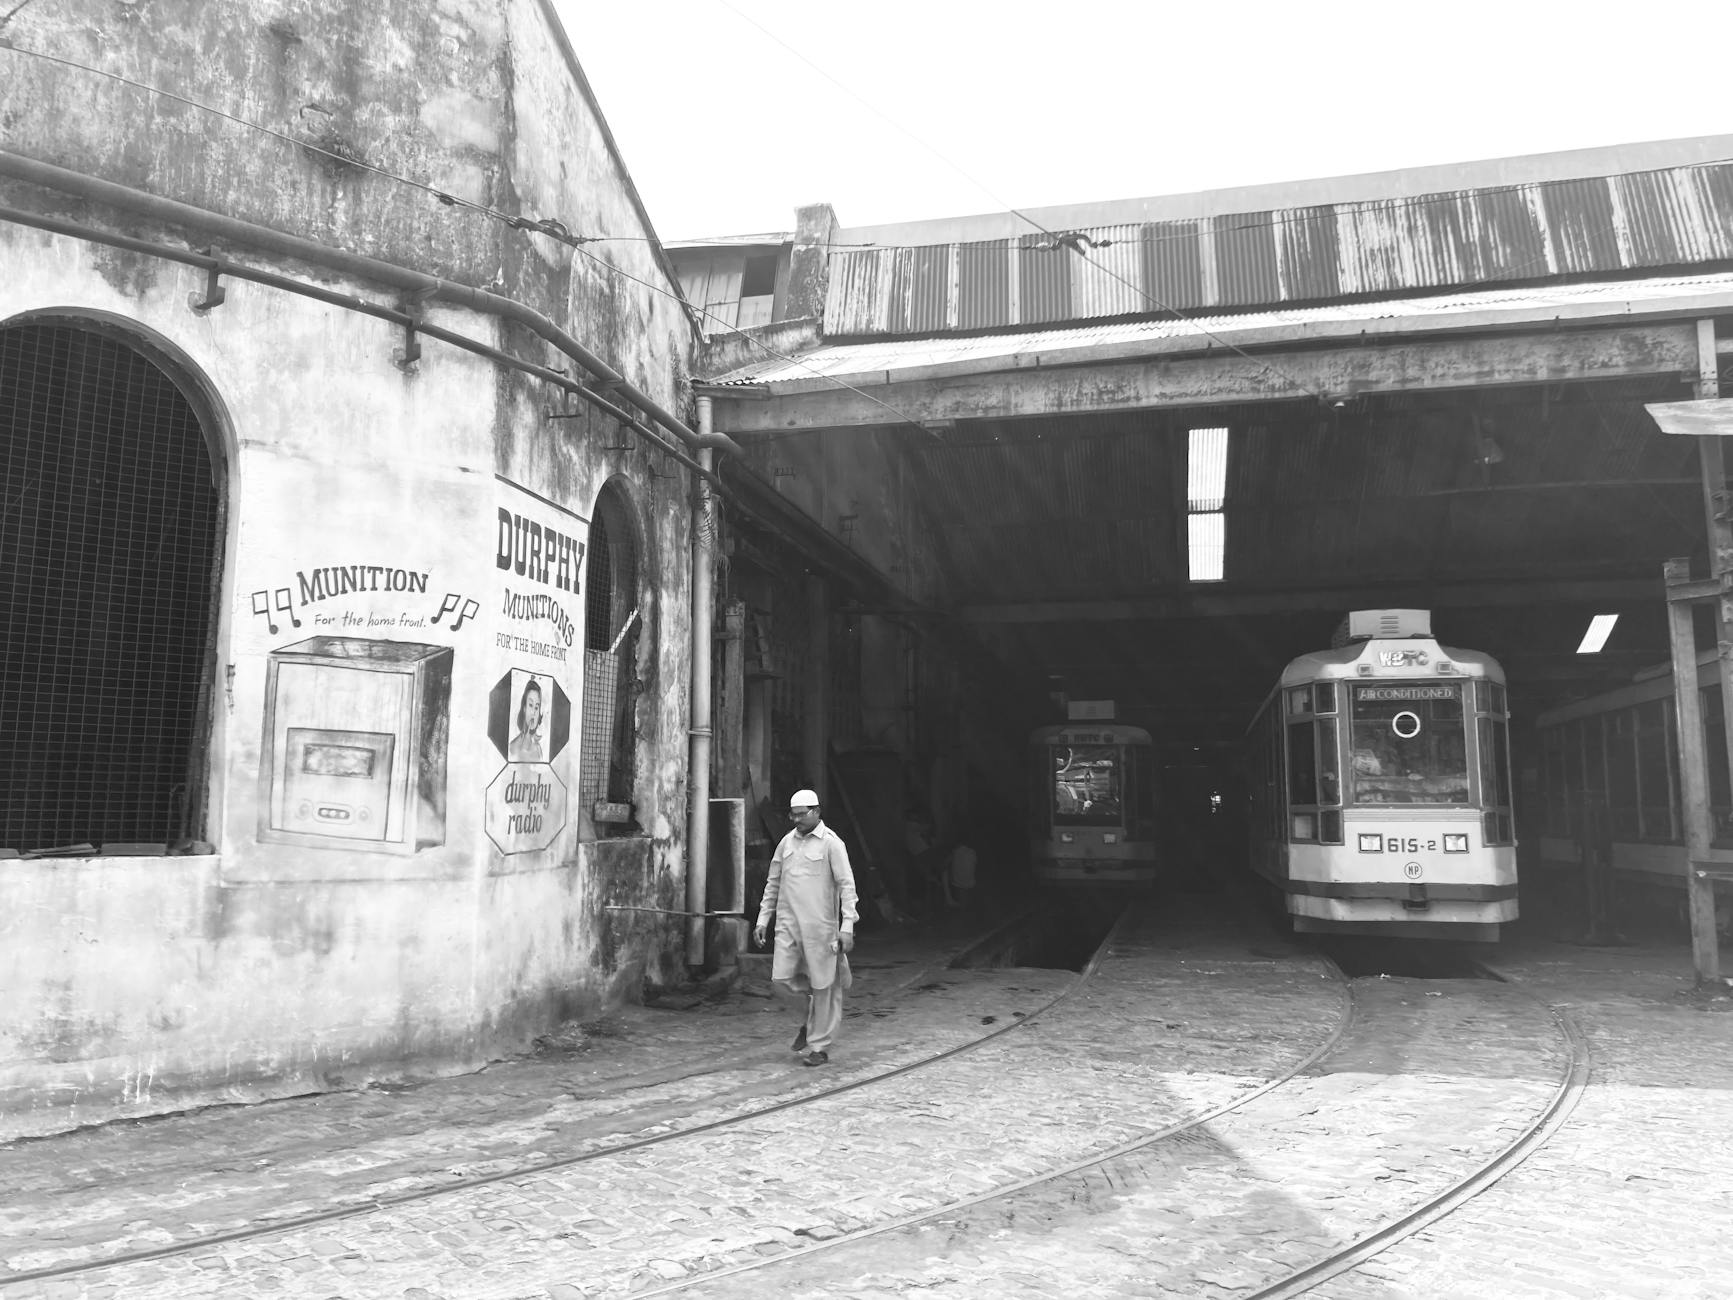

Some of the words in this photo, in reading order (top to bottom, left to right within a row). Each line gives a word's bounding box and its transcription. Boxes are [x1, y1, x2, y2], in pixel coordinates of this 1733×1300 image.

[496, 506, 585, 595] DURPHY
[296, 565, 429, 606] MUNITION
[314, 613, 335, 625] For
[342, 610, 363, 627] the
[503, 587, 574, 647] MUNITIONS
[496, 632, 511, 649] FOR
[514, 636, 529, 652] THE
[530, 640, 549, 657] HOME
[505, 770, 551, 810] durphy
[507, 806, 542, 835] radio
